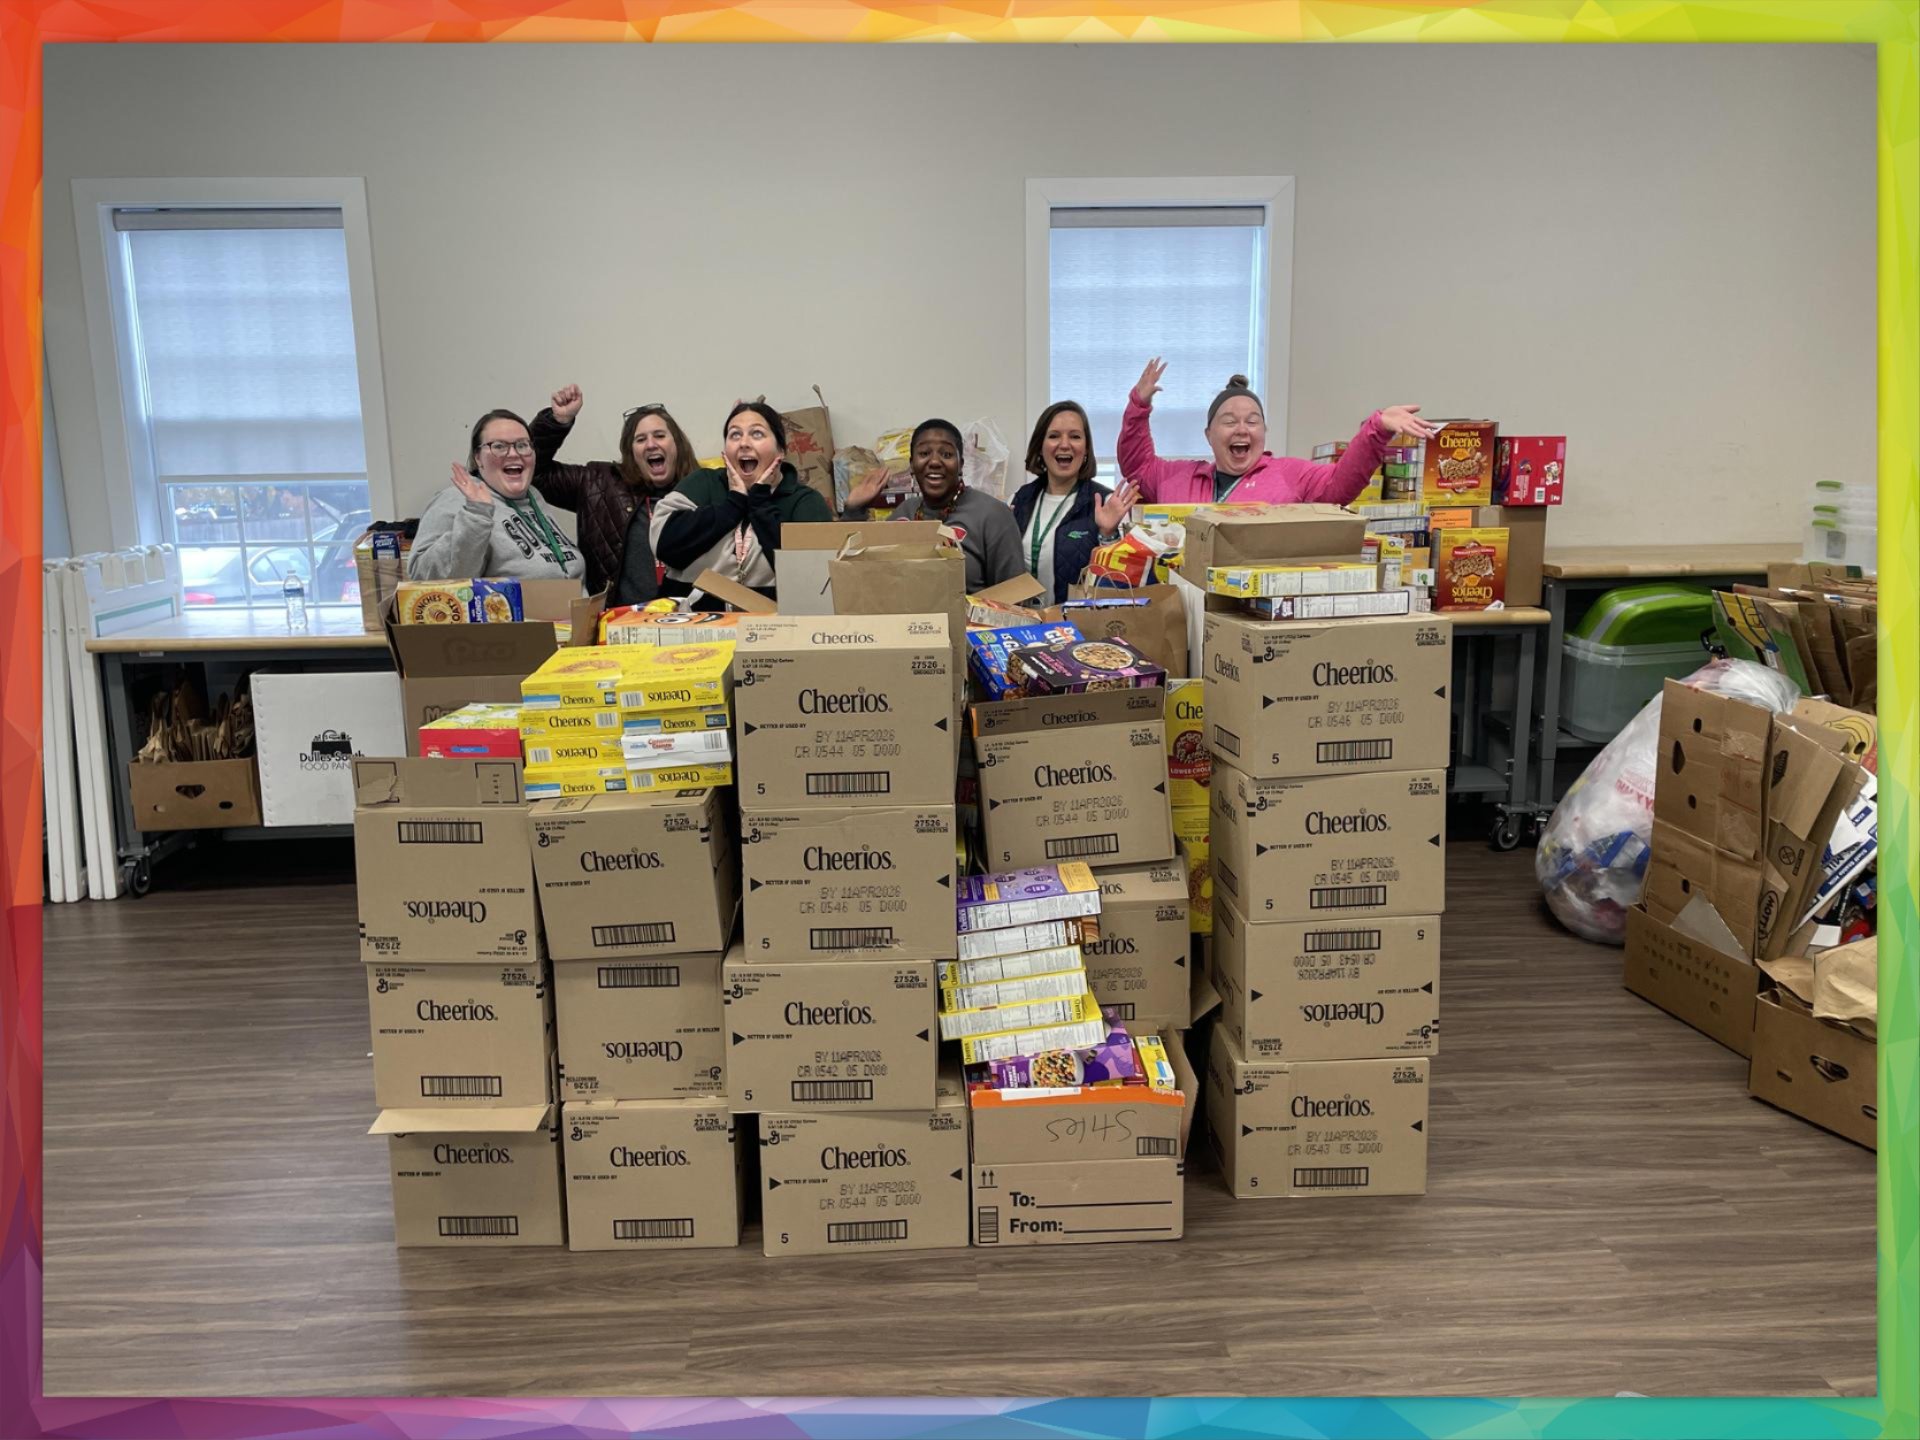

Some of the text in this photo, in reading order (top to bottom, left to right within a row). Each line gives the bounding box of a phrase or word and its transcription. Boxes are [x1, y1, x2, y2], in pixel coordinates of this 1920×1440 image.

[1440, 435, 1482, 448] Cheerios
[1452, 586, 1493, 599] Cheerios
[415, 594, 442, 621] BUNCHES
[908, 624, 934, 632] 27526
[811, 631, 875, 645] Cheerios
[1416, 632, 1440, 641] 27526
[911, 660, 938, 670] 27526
[1214, 652, 1240, 683] Cheerios
[1312, 658, 1394, 687] Cheerios
[562, 694, 595, 706] Cheerios
[648, 690, 692, 703] Cheerios
[798, 686, 889, 714] Cheerios
[1327, 700, 1342, 714] BY
[549, 715, 592, 729] Cheerios
[663, 717, 696, 729] Cheerios
[1042, 710, 1097, 726] Cheerios
[816, 730, 832, 743] BY
[1130, 732, 1154, 742] 27526
[300, 750, 332, 762] Dulles
[556, 746, 598, 760] Cheerios
[1272, 753, 1280, 764] 5
[300, 762, 351, 771] FOOD PAN
[658, 770, 700, 784] Cheerios
[1034, 759, 1112, 788] Cheerios
[562, 782, 596, 794] Cheerios
[757, 783, 766, 795] 5
[1409, 782, 1433, 791] 27526
[1053, 802, 1067, 813] BY
[664, 818, 690, 827] 27526
[914, 820, 940, 828] 27526
[1305, 808, 1388, 836] Cheerios
[580, 846, 660, 873] Cheerios
[804, 844, 892, 872] Cheerios
[1003, 851, 1010, 862] 5
[1331, 859, 1344, 872] BY
[1150, 870, 1173, 879] 27526
[820, 887, 837, 900] BY
[1100, 880, 1122, 896] rios
[1265, 898, 1274, 910] 5
[408, 900, 488, 924] Cheerios
[1155, 910, 1178, 918] 27526
[1417, 929, 1425, 940] 5
[374, 942, 400, 950] 27526
[762, 938, 770, 950] 5
[1082, 932, 1136, 956] eerios
[501, 973, 527, 981] 27526
[894, 975, 920, 983] 27526
[1348, 967, 1360, 980] BY
[416, 998, 494, 1022] Cheerios
[784, 999, 872, 1026] Cheerios
[1304, 1002, 1384, 1028] Cheerios
[605, 1040, 683, 1064] Cheerios
[1258, 1042, 1282, 1052] 27526
[815, 1052, 828, 1064] BY
[1392, 1071, 1416, 1080] 27526
[574, 1082, 599, 1090] 27526
[744, 1089, 752, 1101] 5
[1291, 1093, 1370, 1118] Cheerios
[693, 1118, 720, 1126] 27526
[928, 1118, 954, 1127] 27526
[1306, 1130, 1321, 1143] BY
[434, 1142, 510, 1165] Cheerios
[610, 1144, 688, 1168] Cheerios
[820, 1143, 908, 1170] Cheerios
[1250, 1177, 1258, 1188] 5
[840, 1184, 856, 1196] BY
[1009, 1191, 1036, 1208] To:
[1009, 1218, 1063, 1234] From:
[780, 1232, 790, 1244] 5
